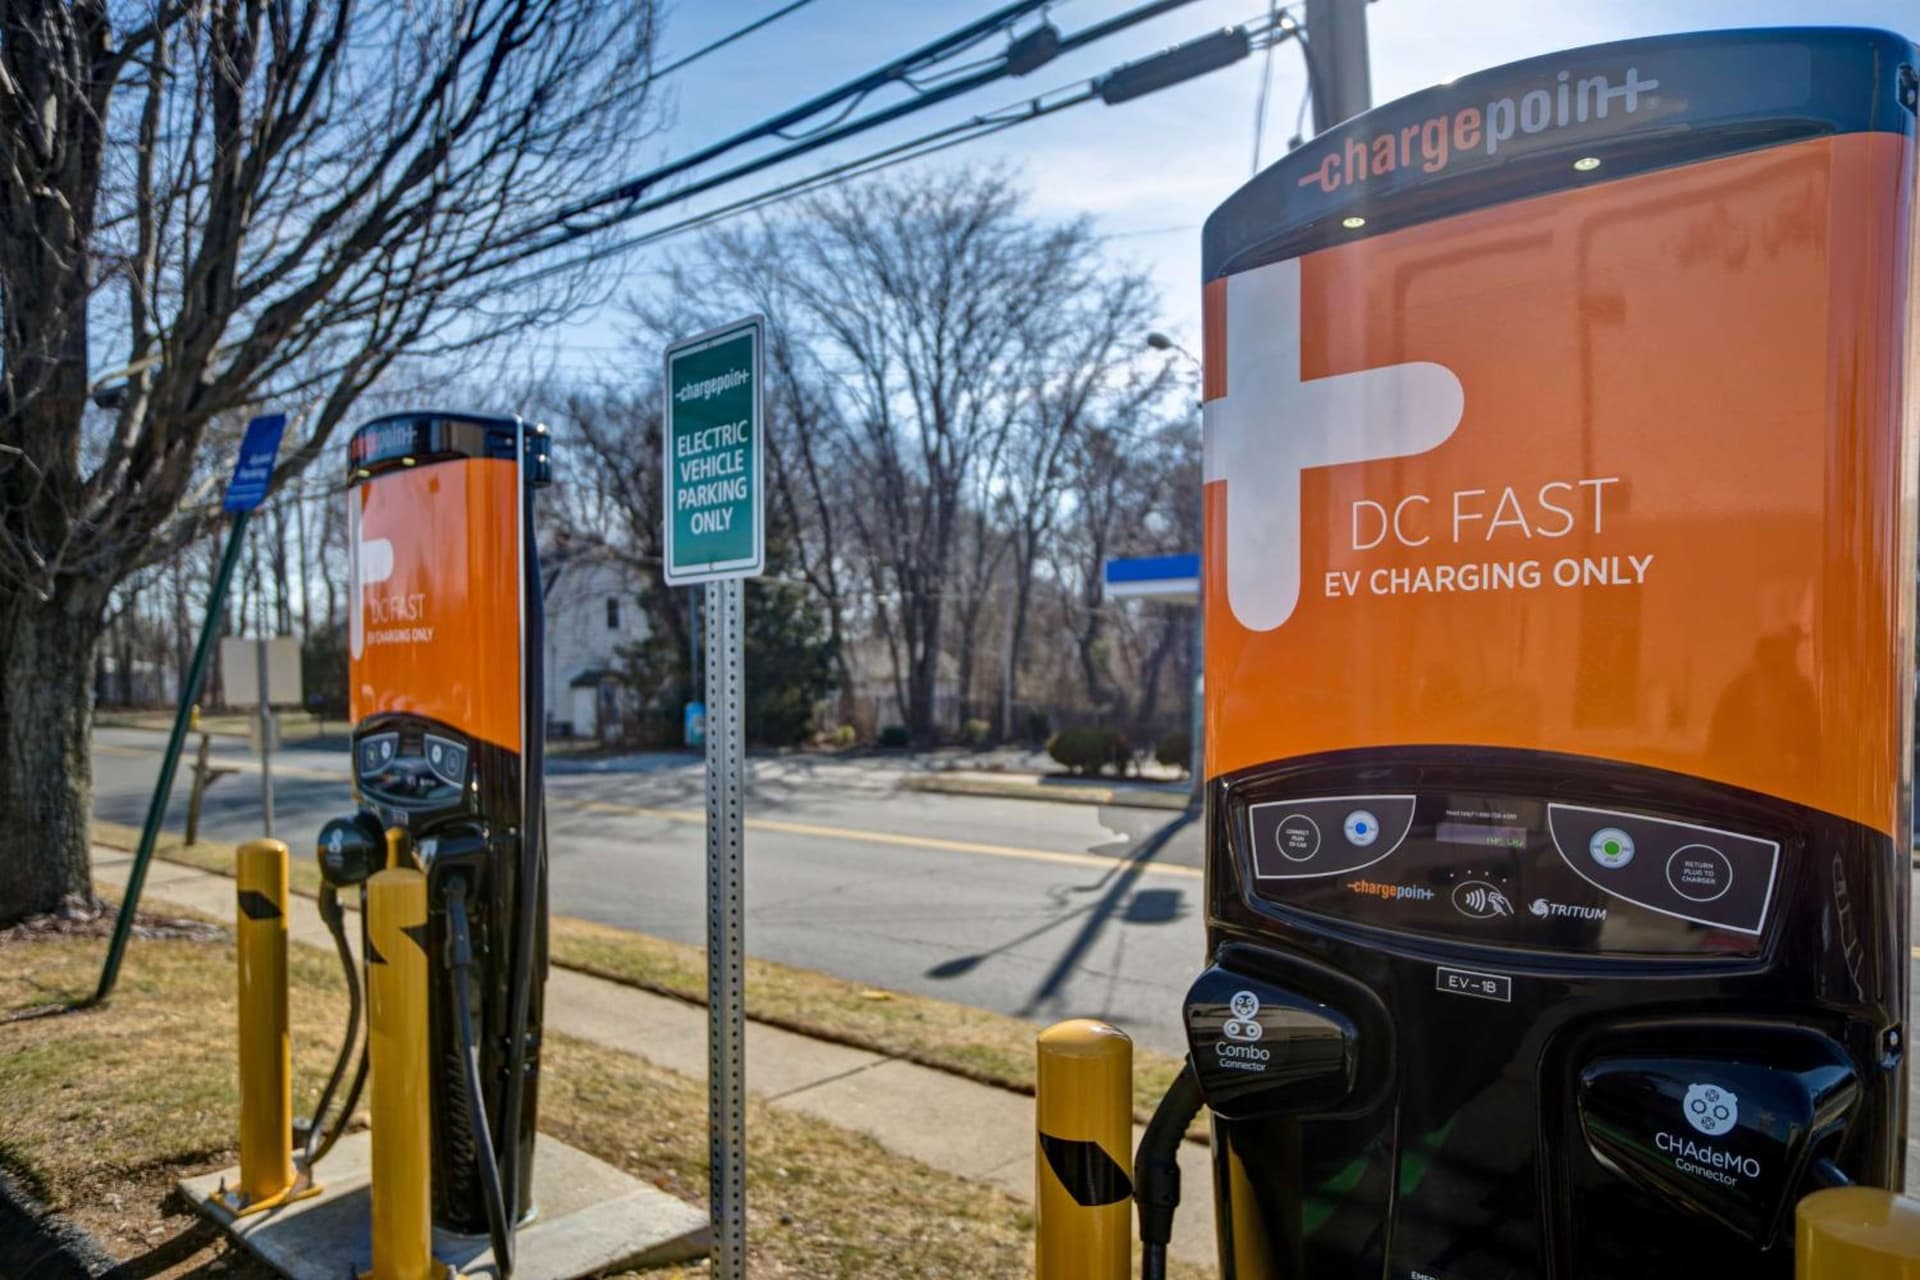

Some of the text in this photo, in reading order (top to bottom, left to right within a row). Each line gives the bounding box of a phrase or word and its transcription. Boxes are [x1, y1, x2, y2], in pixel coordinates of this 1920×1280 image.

[677, 420, 749, 457] ELECTRIC
[680, 449, 745, 483] VEHICLE
[677, 476, 748, 511] PARKING
[690, 507, 735, 536] ONLY
[1352, 477, 1620, 551] DC FAST
[1324, 554, 1655, 598] EV CHARGING ONLY
[391, 593, 426, 621] FAST
[412, 626, 434, 643] ONLY
[1683, 868, 1703, 877] PLUG
[1685, 860, 1714, 869] RETURN
[1550, 903, 1607, 920] TRITIUM
[1215, 1041, 1270, 1061] Combo
[1219, 1058, 1266, 1072] Connector
[1655, 1131, 1761, 1178] CHAdeMO
[1674, 1157, 1738, 1187] Connector
